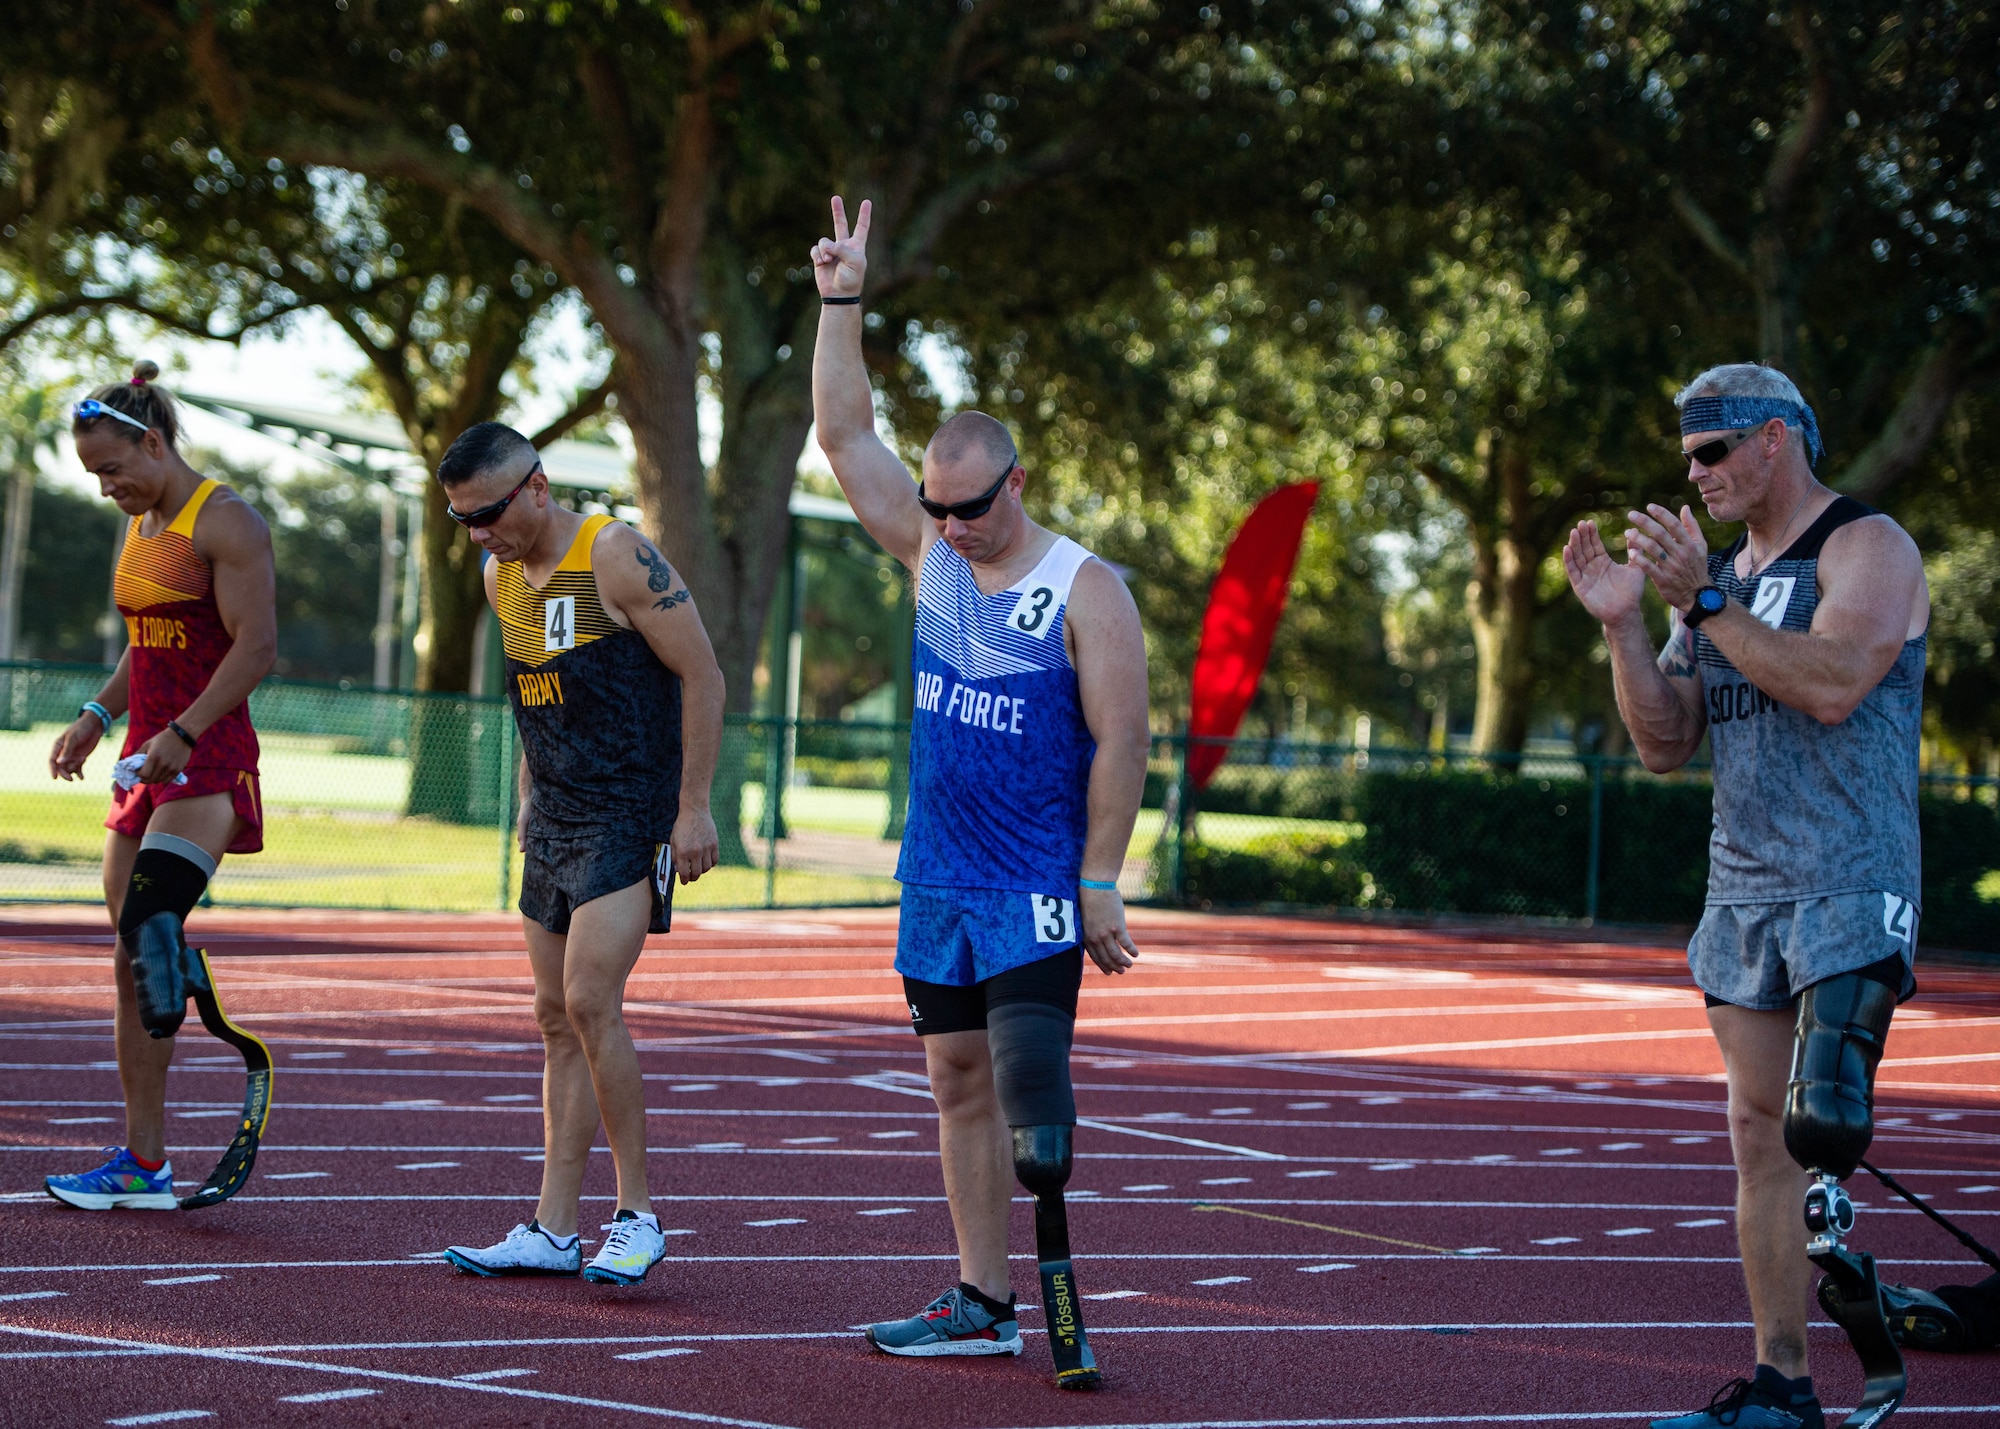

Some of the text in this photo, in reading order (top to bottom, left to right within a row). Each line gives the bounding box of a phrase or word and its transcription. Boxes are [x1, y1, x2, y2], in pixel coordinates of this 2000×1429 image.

[549, 600, 567, 647] 4
[1017, 587, 1053, 632] 3
[1756, 580, 1785, 627] 2
[142, 616, 187, 650] CORPS
[517, 671, 564, 707] ARMY
[916, 671, 1026, 735] AIR FORCE
[659, 845, 668, 892] 4
[1041, 894, 1066, 942] 3
